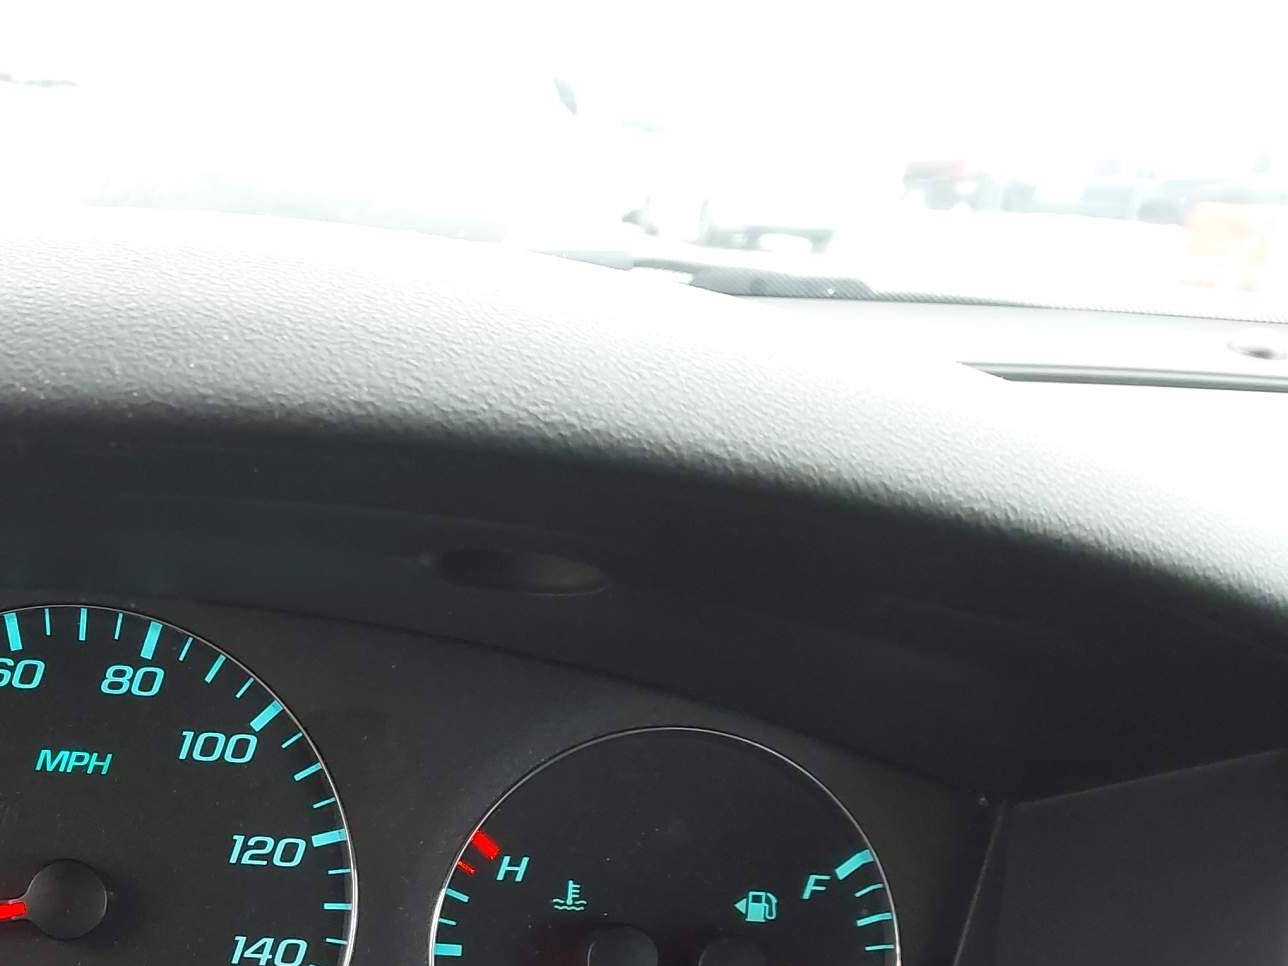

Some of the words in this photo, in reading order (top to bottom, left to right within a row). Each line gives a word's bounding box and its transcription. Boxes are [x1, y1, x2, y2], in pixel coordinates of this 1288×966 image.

[100, 665, 165, 697] 80
[35, 748, 113, 775] MPH
[178, 730, 258, 764] 100
[228, 834, 307, 867] 120
[496, 855, 530, 882] H
[802, 874, 831, 900] F
